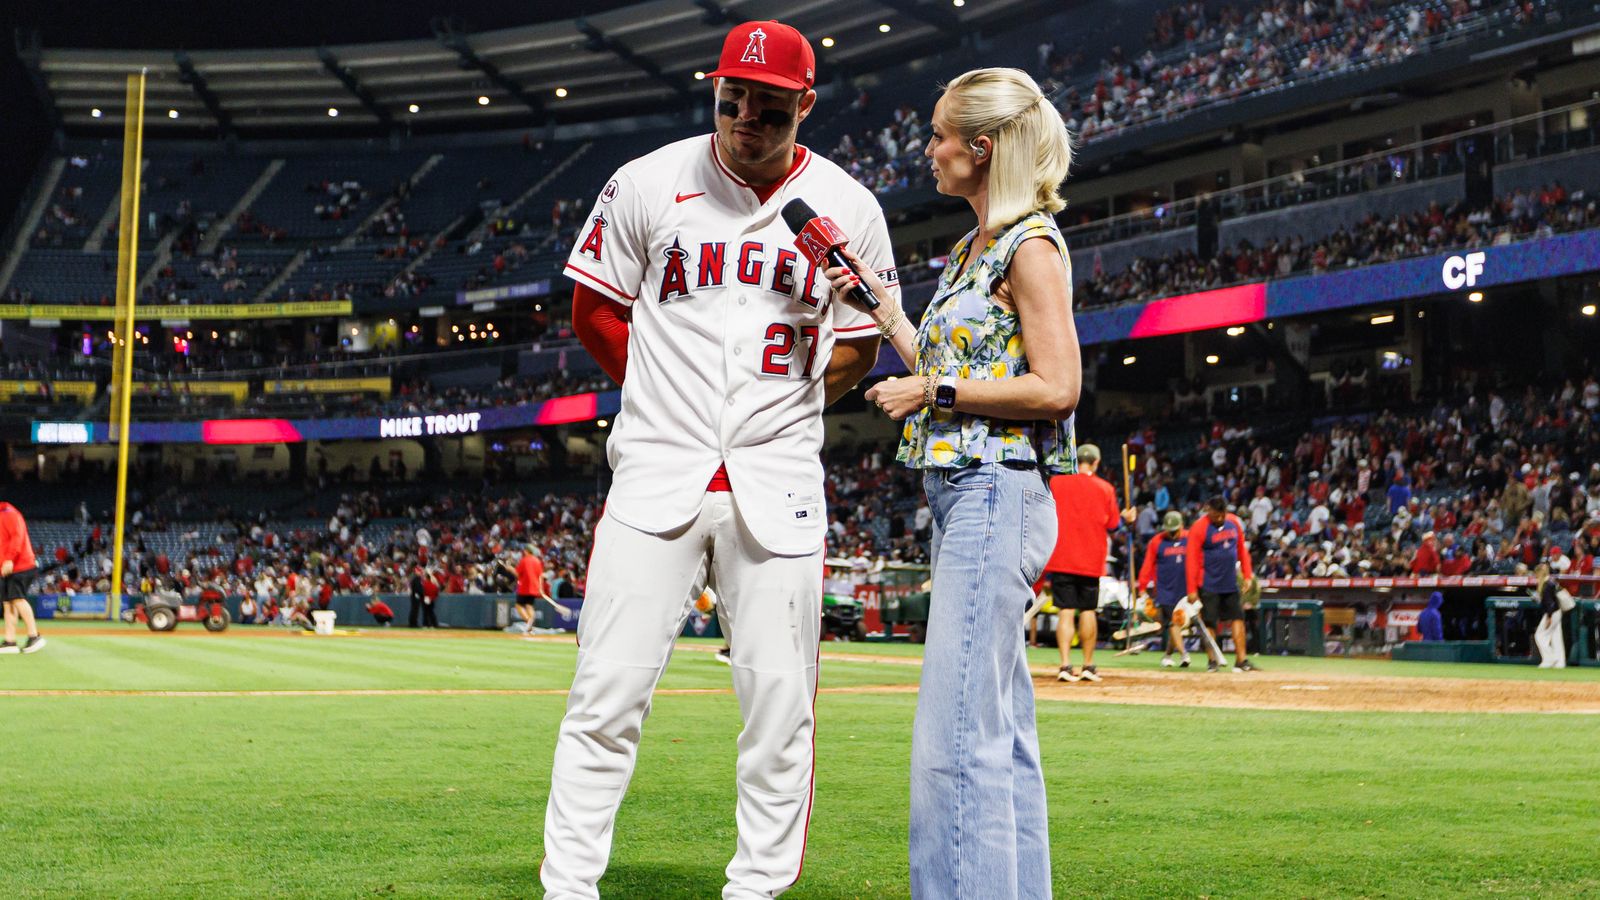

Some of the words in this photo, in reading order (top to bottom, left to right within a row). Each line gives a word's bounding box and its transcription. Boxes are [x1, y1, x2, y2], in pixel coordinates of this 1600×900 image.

[741, 28, 767, 64] A
[579, 211, 608, 262] A
[801, 231, 828, 263] A
[659, 234, 832, 316] ANGEL
[1442, 251, 1486, 290] CF
[761, 322, 819, 377] 27
[380, 417, 422, 438] MIKE
[424, 413, 481, 435] TROUT
